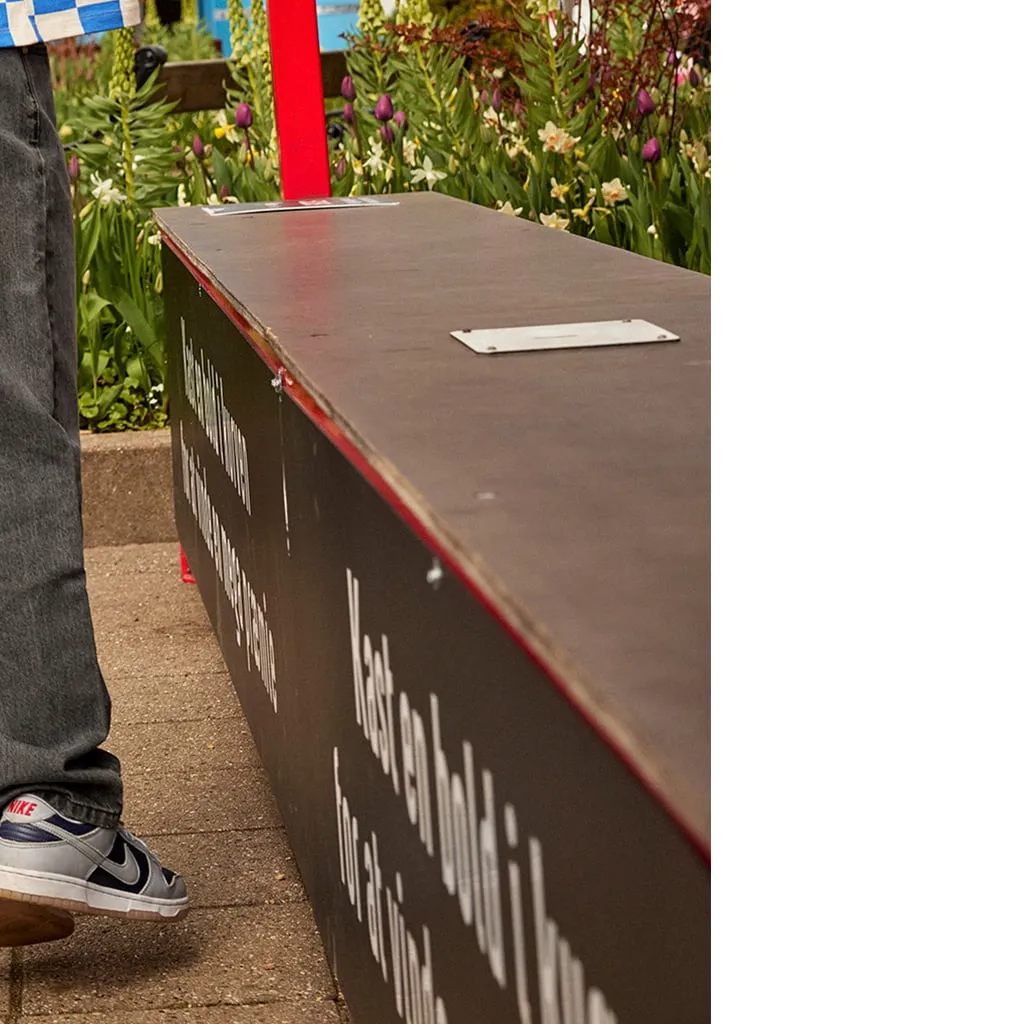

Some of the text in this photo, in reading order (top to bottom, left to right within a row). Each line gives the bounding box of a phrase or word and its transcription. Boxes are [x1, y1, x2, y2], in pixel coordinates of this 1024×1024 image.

[6, 800, 38, 817] NIKE
[333, 747, 449, 1024] for at vind
[346, 568, 400, 795] Kast
[399, 691, 434, 856] en
[429, 691, 506, 989] bold
[504, 802, 532, 1024] i
